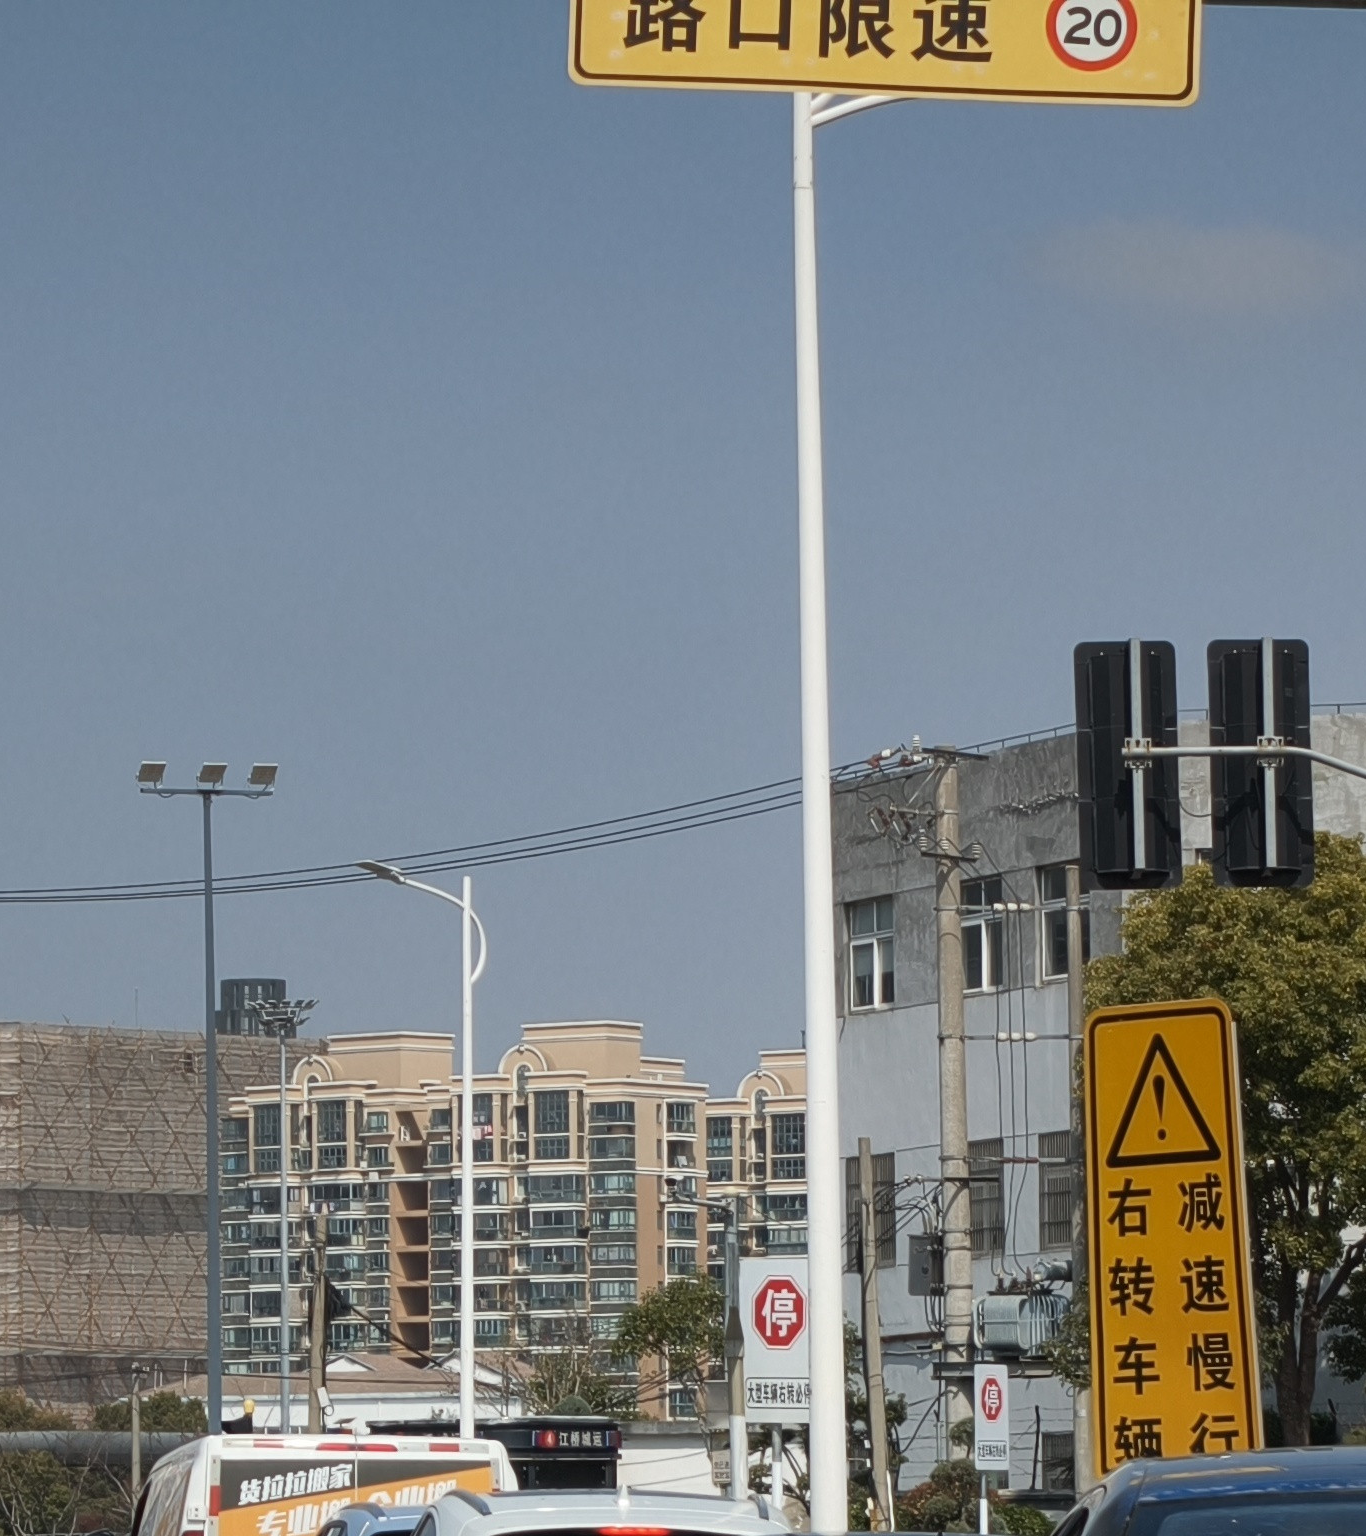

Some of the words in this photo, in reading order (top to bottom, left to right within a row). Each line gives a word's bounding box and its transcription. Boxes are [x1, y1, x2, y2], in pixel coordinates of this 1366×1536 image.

[622, 0, 993, 63] 路口限速
[1063, 6, 1122, 47] 20
[761, 1288, 797, 1338] 停
[984, 1384, 999, 1415] 停
